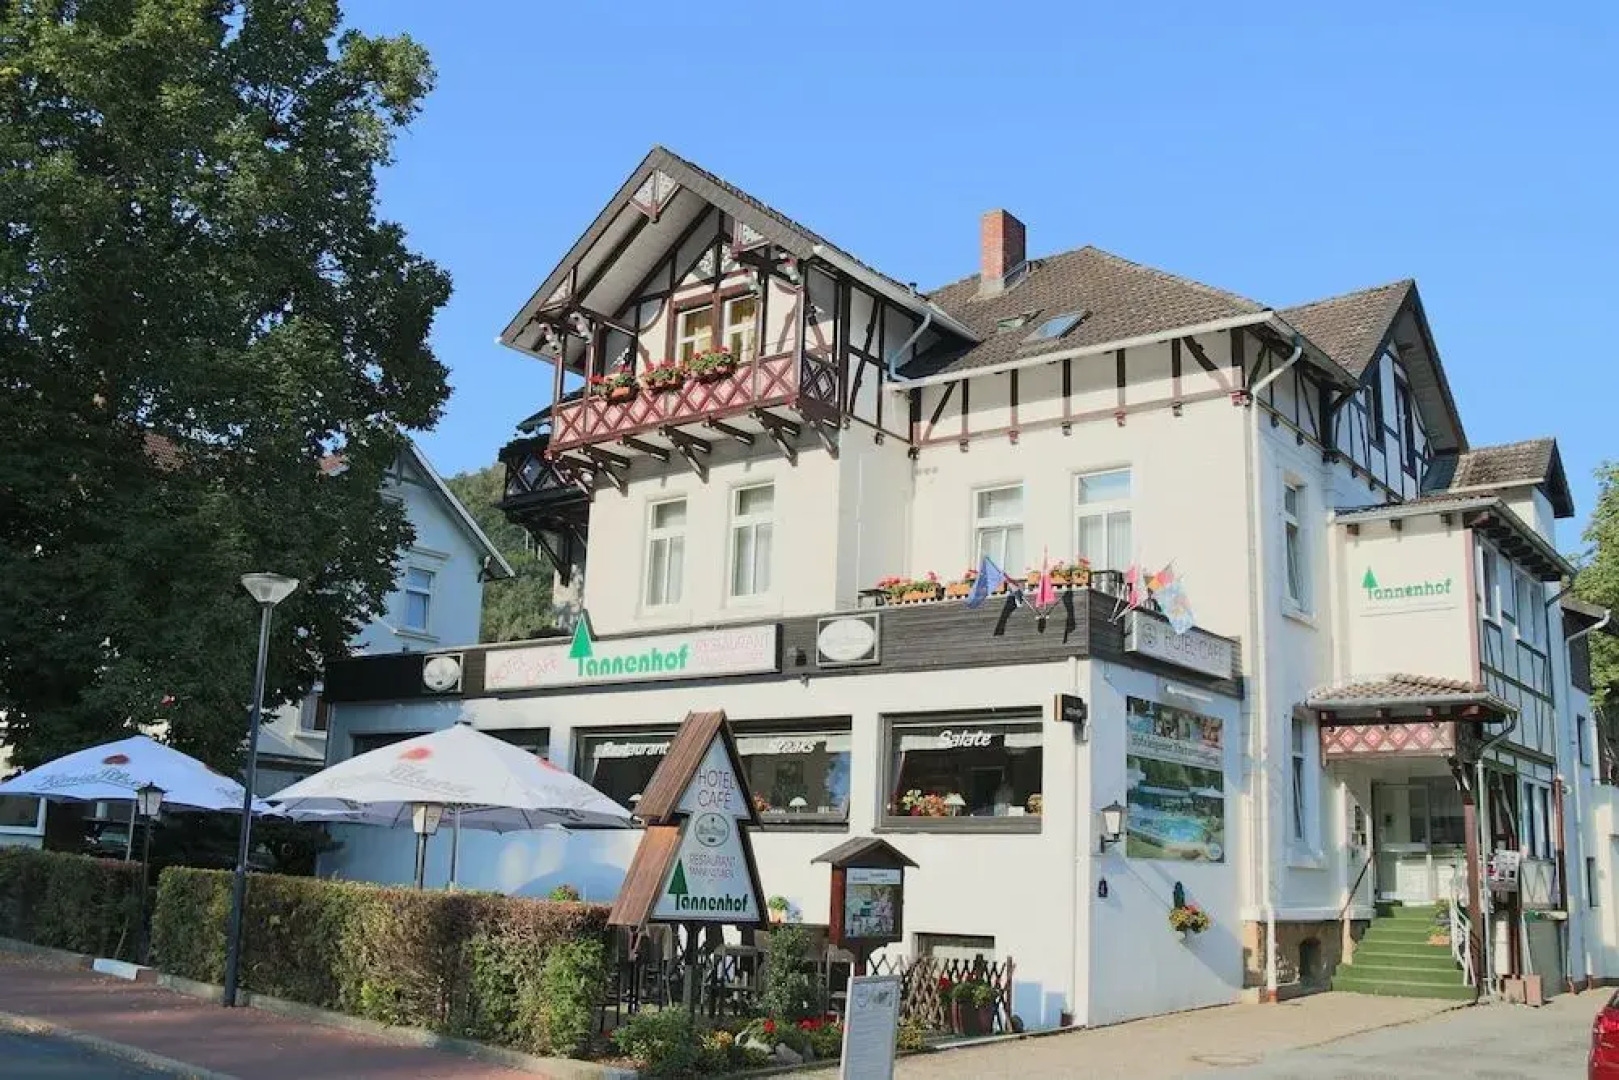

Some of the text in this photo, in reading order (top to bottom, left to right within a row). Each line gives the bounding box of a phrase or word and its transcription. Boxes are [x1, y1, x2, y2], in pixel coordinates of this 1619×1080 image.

[1362, 577, 1452, 601] Tannenhof
[569, 642, 688, 677] Tannenhof
[940, 729, 992, 748] Salate
[698, 765, 736, 790] HOTEL
[668, 891, 749, 913] Tannenhof
